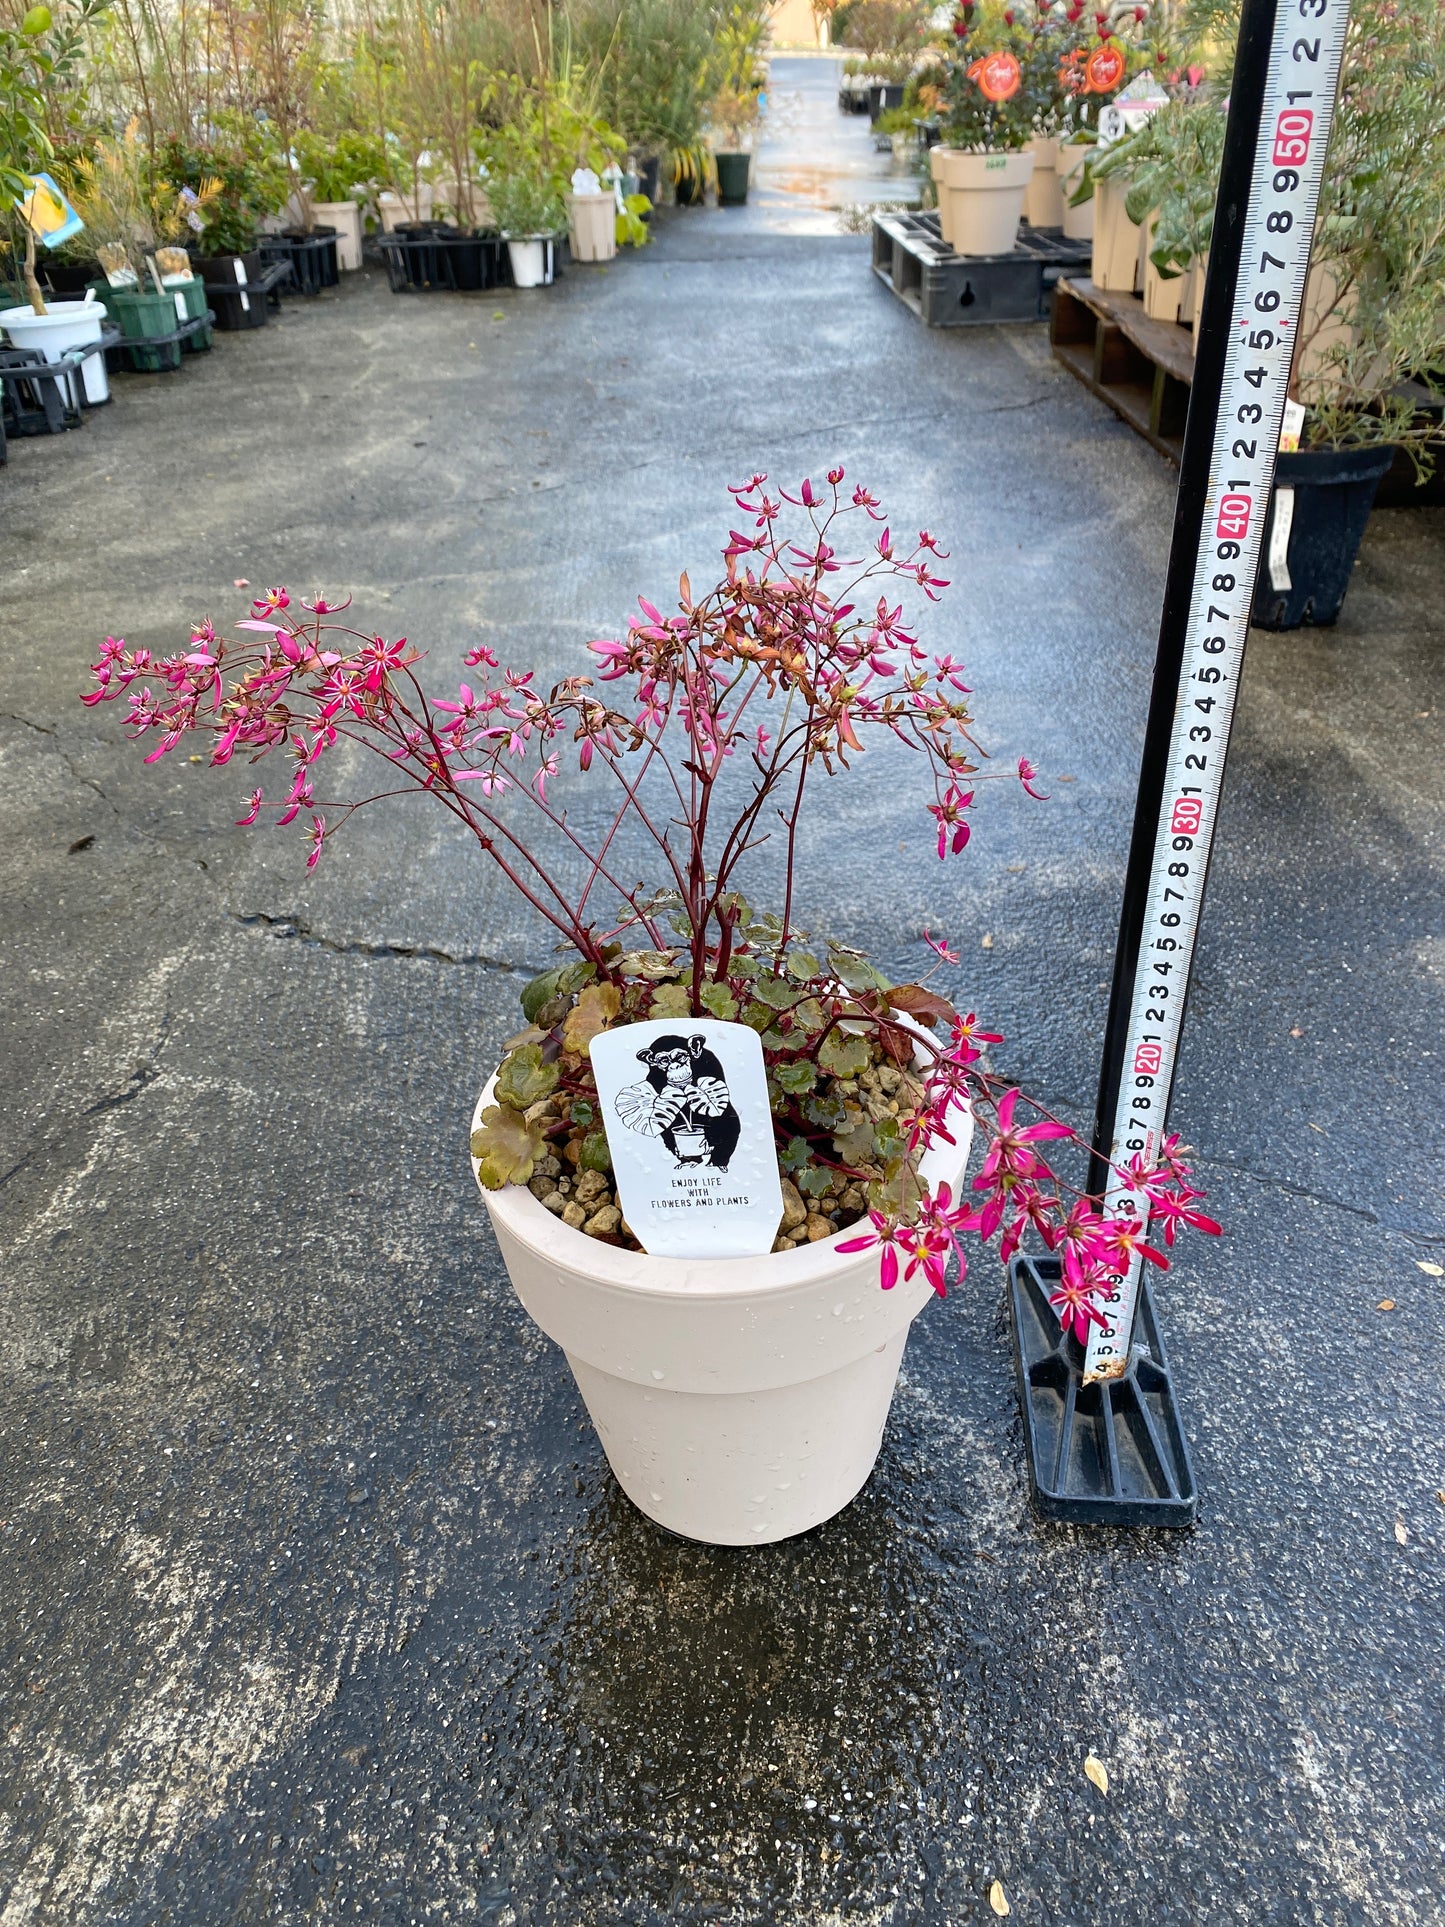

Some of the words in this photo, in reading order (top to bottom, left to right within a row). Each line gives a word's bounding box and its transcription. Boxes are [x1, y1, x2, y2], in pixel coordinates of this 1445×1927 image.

[1293, 38, 1321, 62] 2
[1287, 91, 1312, 105] 1
[1276, 116, 1310, 158] 50
[1273, 169, 1299, 192] 9
[1267, 211, 1293, 233] 8
[1260, 252, 1285, 273] 7
[1255, 291, 1280, 312] 6
[1249, 330, 1274, 350] 5
[1244, 367, 1268, 388] 4
[1238, 404, 1262, 424] 3
[1232, 439, 1257, 458] 2
[1228, 481, 1250, 491] 1
[1221, 500, 1248, 533] 40
[1217, 541, 1240, 559] 9
[1212, 574, 1235, 592] 8
[1207, 606, 1229, 622] 7
[1203, 637, 1225, 654] 6
[1198, 667, 1220, 683] 5
[1195, 697, 1216, 713] 4
[1190, 726, 1211, 742] 3
[1185, 754, 1207, 770] 2
[1181, 787, 1202, 795] 1
[1174, 802, 1199, 829] 30
[1172, 836, 1193, 851] 9
[1168, 863, 1189, 877] 8
[1164, 888, 1184, 901] 7
[1160, 913, 1180, 926] 6
[1157, 938, 1176, 951] 5
[1153, 962, 1172, 975] 4
[1149, 986, 1168, 998] 3
[1146, 1009, 1165, 1022] 2
[1137, 1047, 1159, 1070] 20
[1136, 1076, 1154, 1088] 9
[1132, 1097, 1150, 1109] 8
[1129, 1118, 1146, 1129] 7
[1126, 1139, 1144, 1150] 6
[672, 1179, 698, 1188] ENJOY
[702, 1177, 722, 1187] LIFE
[687, 1188, 709, 1197] WITH
[651, 1199, 691, 1208] FLOWERS
[696, 1198, 713, 1207] AND
[716, 1196, 749, 1206] PLANTS
[1100, 1328, 1115, 1338] 6
[1098, 1346, 1113, 1355] 5
[1096, 1362, 1110, 1372] 4
